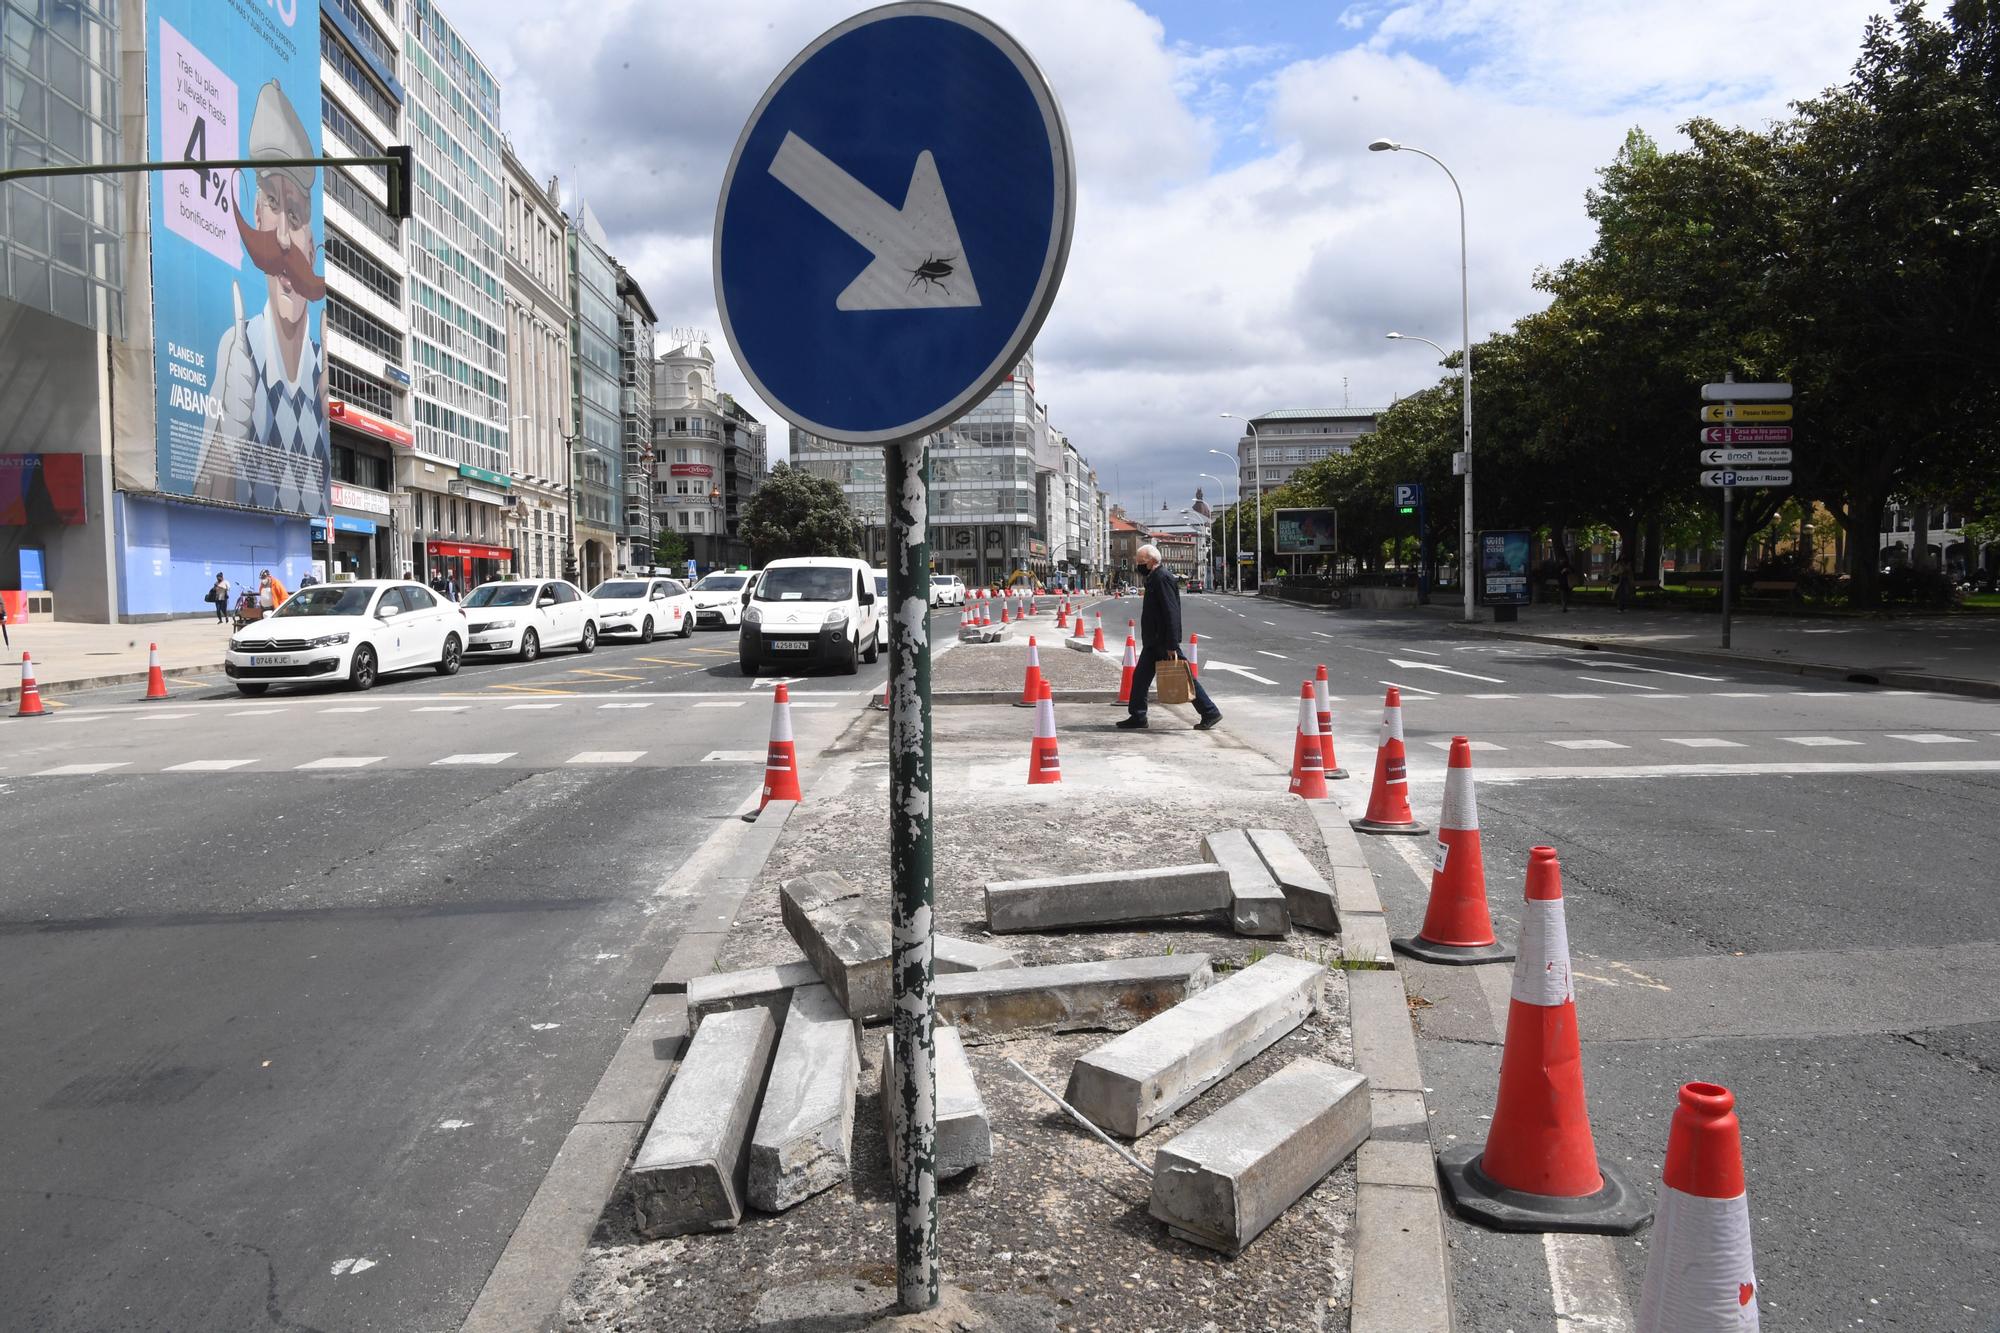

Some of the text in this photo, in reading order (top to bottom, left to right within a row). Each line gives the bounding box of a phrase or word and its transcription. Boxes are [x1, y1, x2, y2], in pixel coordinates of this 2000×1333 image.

[176, 51, 219, 101] Trae tu plan
[176, 76, 183, 92] y
[208, 99, 226, 127] hasta
[177, 98, 188, 116] un
[179, 181, 189, 198] de
[168, 341, 205, 368] PLANES DE
[169, 362, 207, 387] PENSIONES
